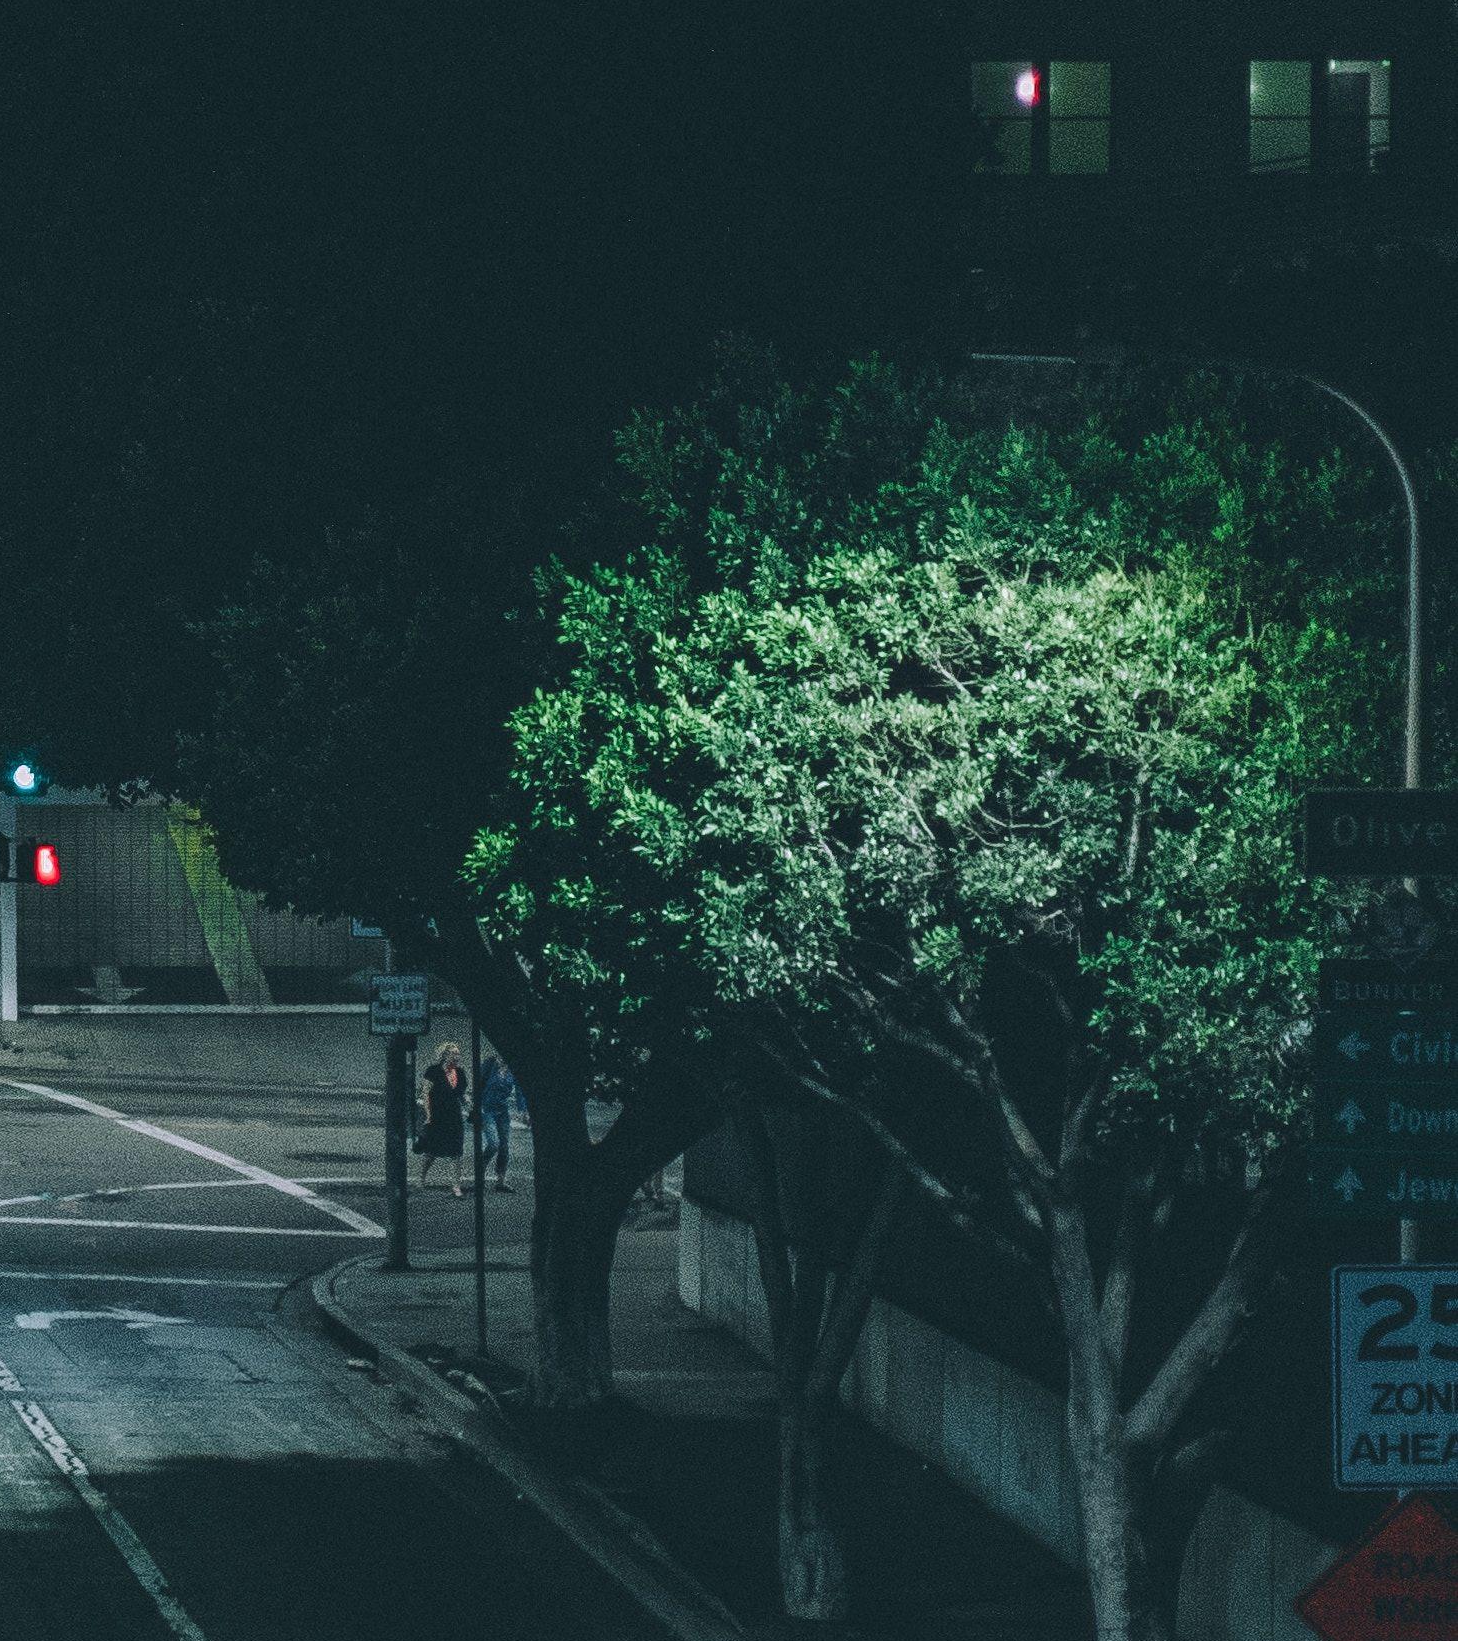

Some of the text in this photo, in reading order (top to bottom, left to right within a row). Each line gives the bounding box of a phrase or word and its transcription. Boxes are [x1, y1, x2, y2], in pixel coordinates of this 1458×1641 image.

[1331, 814, 1447, 847] Olive
[1333, 979, 1444, 1001] BUNKER
[1390, 1031, 1458, 1065] Civi
[1387, 1168, 1458, 1203] Jew
[1370, 1382, 1458, 1416] ZON
